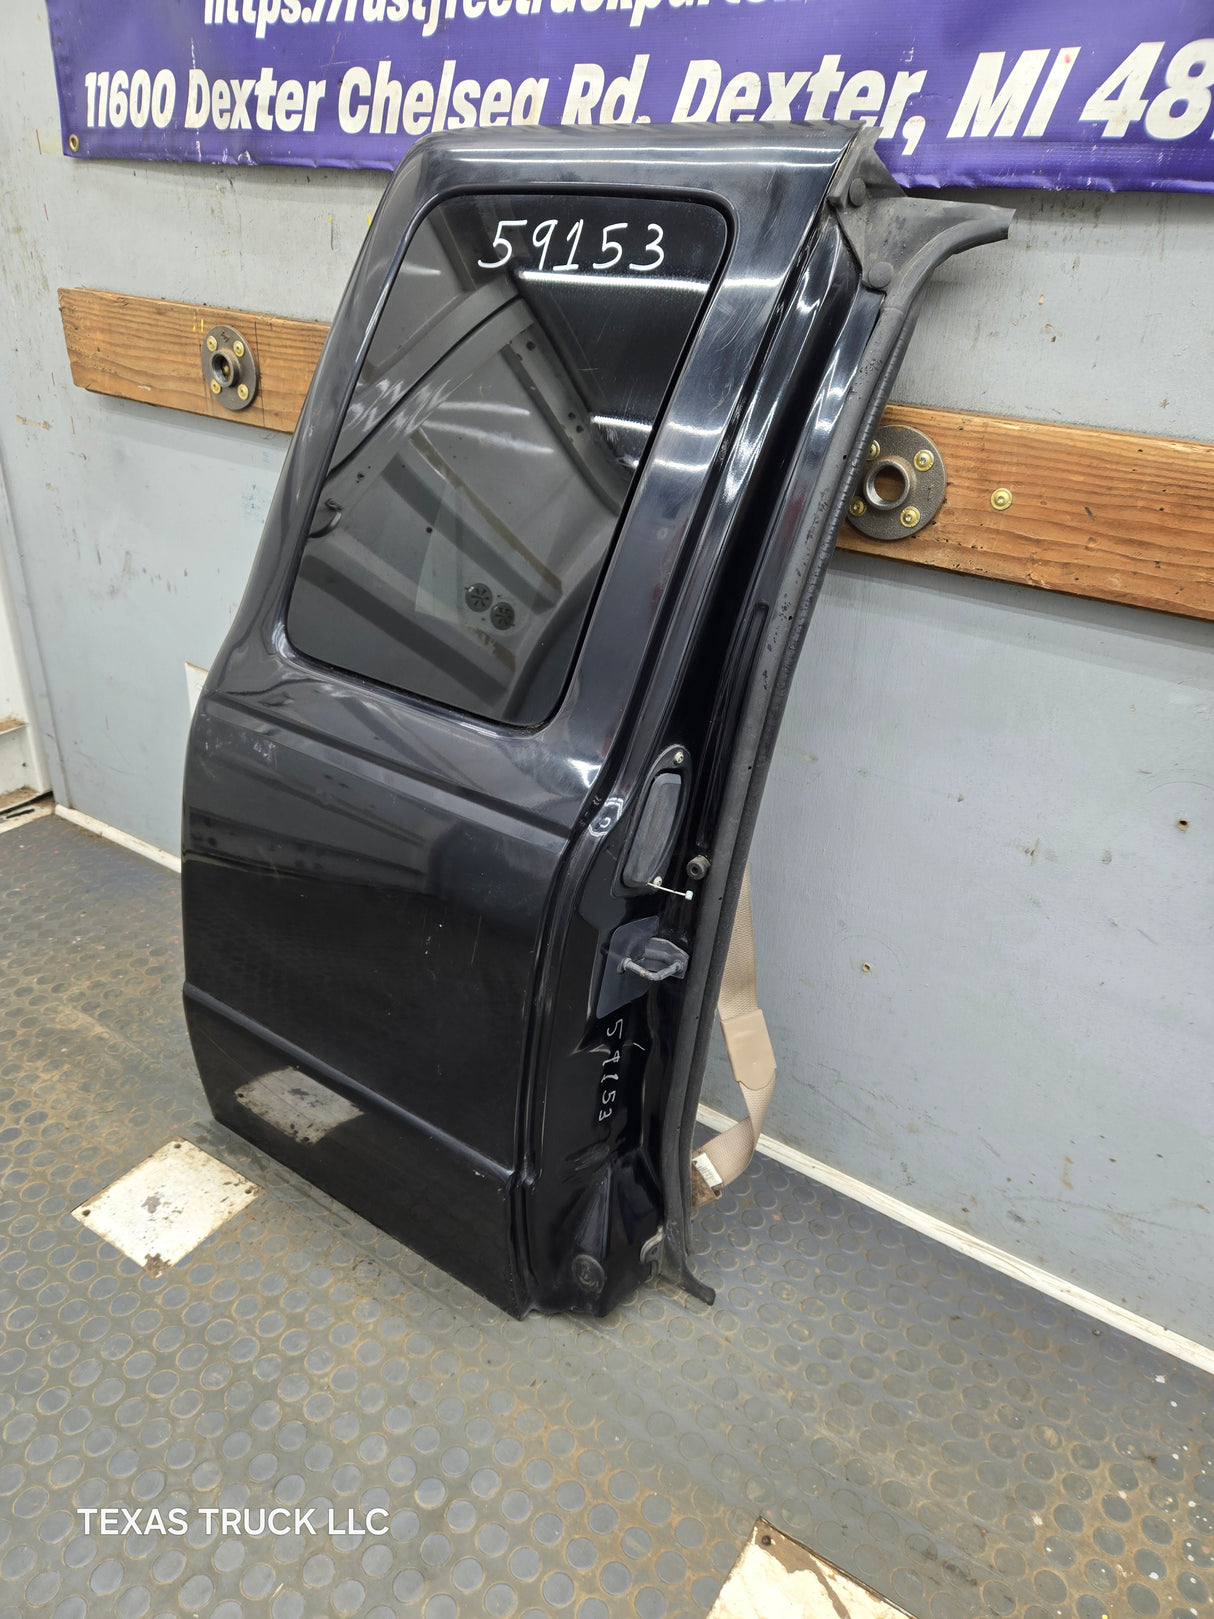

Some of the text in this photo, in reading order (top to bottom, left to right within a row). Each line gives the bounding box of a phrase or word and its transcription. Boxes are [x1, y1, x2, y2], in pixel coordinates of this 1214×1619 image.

[84, 68, 176, 128] 11600
[185, 67, 326, 133] Dexter
[338, 60, 550, 135] Chelsea
[671, 54, 928, 156] Dexter,
[946, 46, 1082, 139] MI
[1080, 37, 1214, 140] 48
[477, 218, 665, 272] 59153
[598, 1018, 624, 1122] 59153
